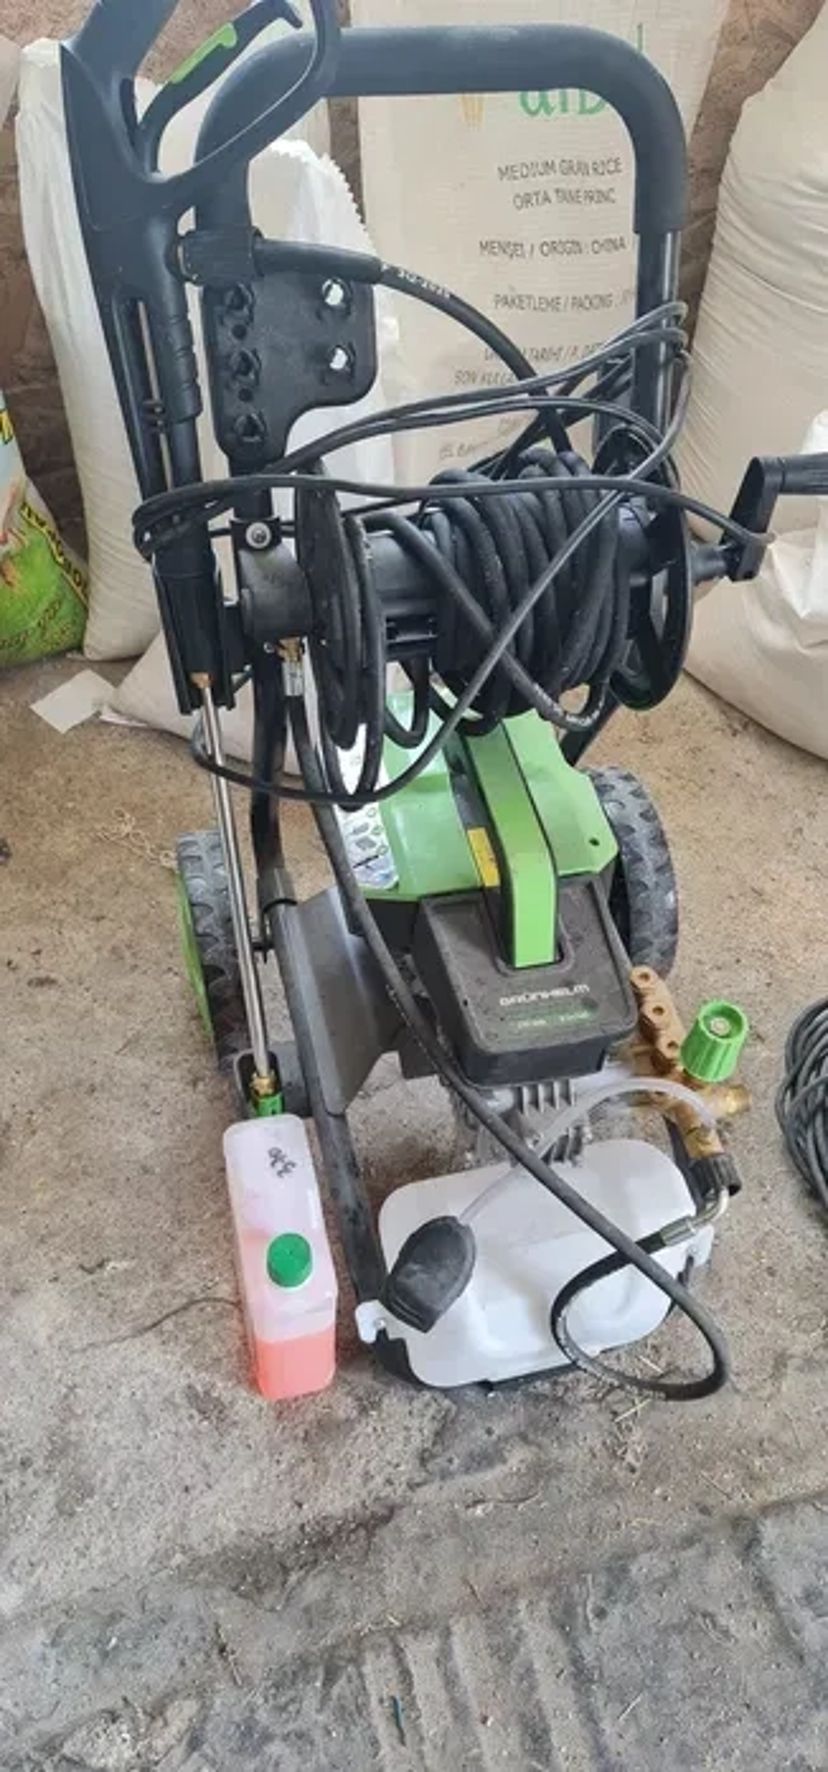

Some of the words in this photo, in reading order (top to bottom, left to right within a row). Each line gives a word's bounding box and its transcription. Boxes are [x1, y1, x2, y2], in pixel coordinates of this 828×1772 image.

[497, 159, 557, 181] MEDIUM
[592, 156, 623, 176] RICE
[512, 189, 552, 211] ORTA
[539, 239, 582, 258] ORIGIN
[591, 236, 627, 255] CHINA
